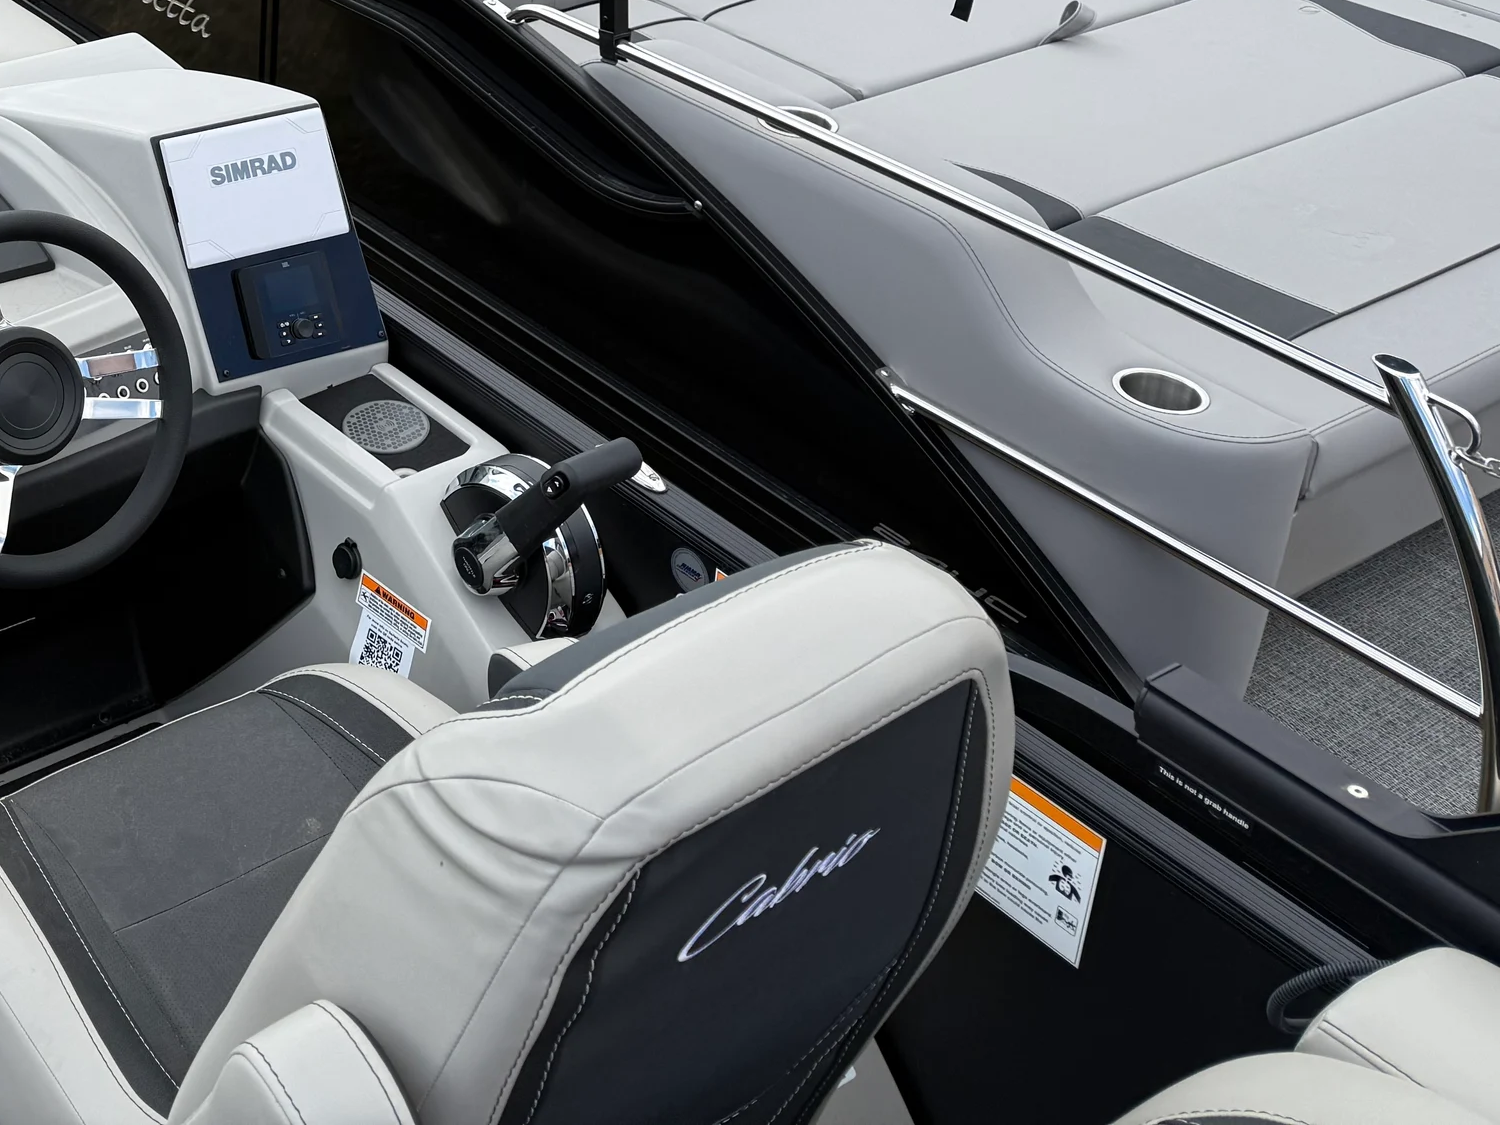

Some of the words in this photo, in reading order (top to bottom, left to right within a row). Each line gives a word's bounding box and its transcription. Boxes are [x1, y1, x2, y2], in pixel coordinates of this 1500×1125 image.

[210, 151, 297, 186] SIMRAD
[382, 591, 415, 621] WARNING
[1159, 765, 1175, 781] This
[1176, 777, 1183, 787] is
[1184, 784, 1197, 796] not
[1204, 797, 1222, 812] grab
[1223, 808, 1250, 830] handle
[677, 828, 881, 962] Cabrio
